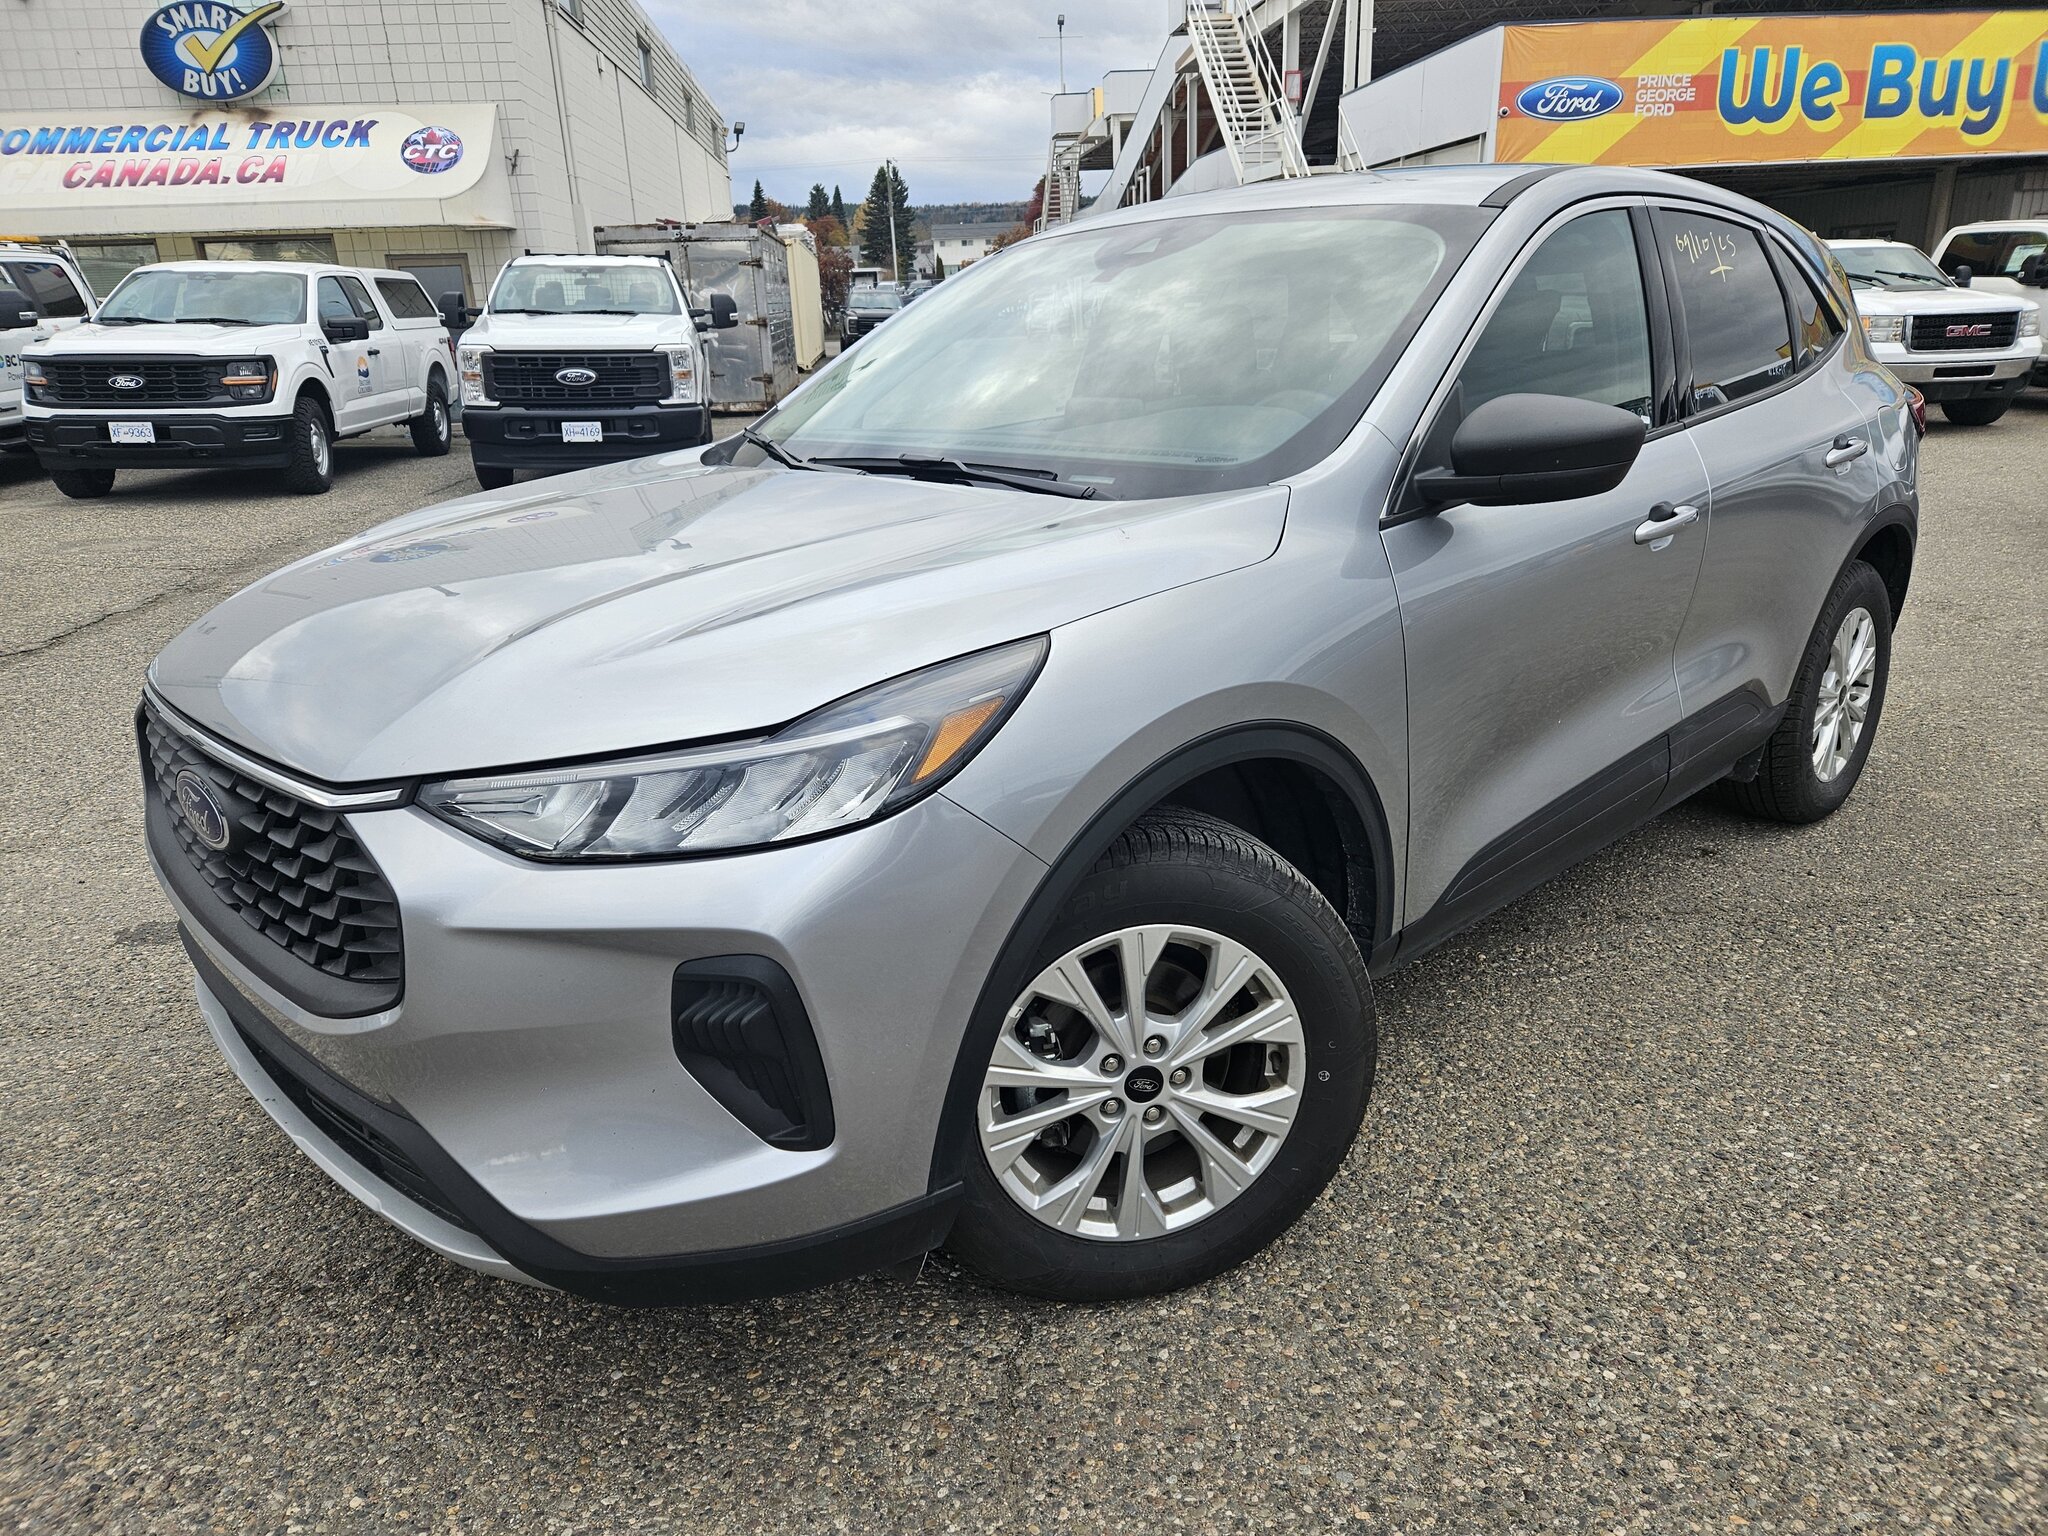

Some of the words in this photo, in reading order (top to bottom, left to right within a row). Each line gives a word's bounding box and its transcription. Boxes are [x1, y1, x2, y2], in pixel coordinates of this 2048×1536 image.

[156, 3, 243, 39] SMART
[183, 67, 246, 96] BUY!
[1637, 73, 1692, 88] PRINCE
[1635, 87, 1697, 103] GEORGE
[1717, 46, 1845, 124] We
[1864, 44, 2011, 135] Buy
[1536, 83, 1604, 114] Ford
[1633, 102, 1675, 117] FORD
[0, 123, 231, 156] OMMERCIAL
[246, 119, 380, 150] TRUCK
[403, 144, 459, 160] CTC
[62, 155, 287, 189] CANADA.CA
[1946, 323, 1993, 337] GMC
[115, 377, 136, 387] Ford
[566, 372, 587, 382] Ford
[181, 786, 211, 835] Ford
[1133, 1080, 1154, 1090] Ford
